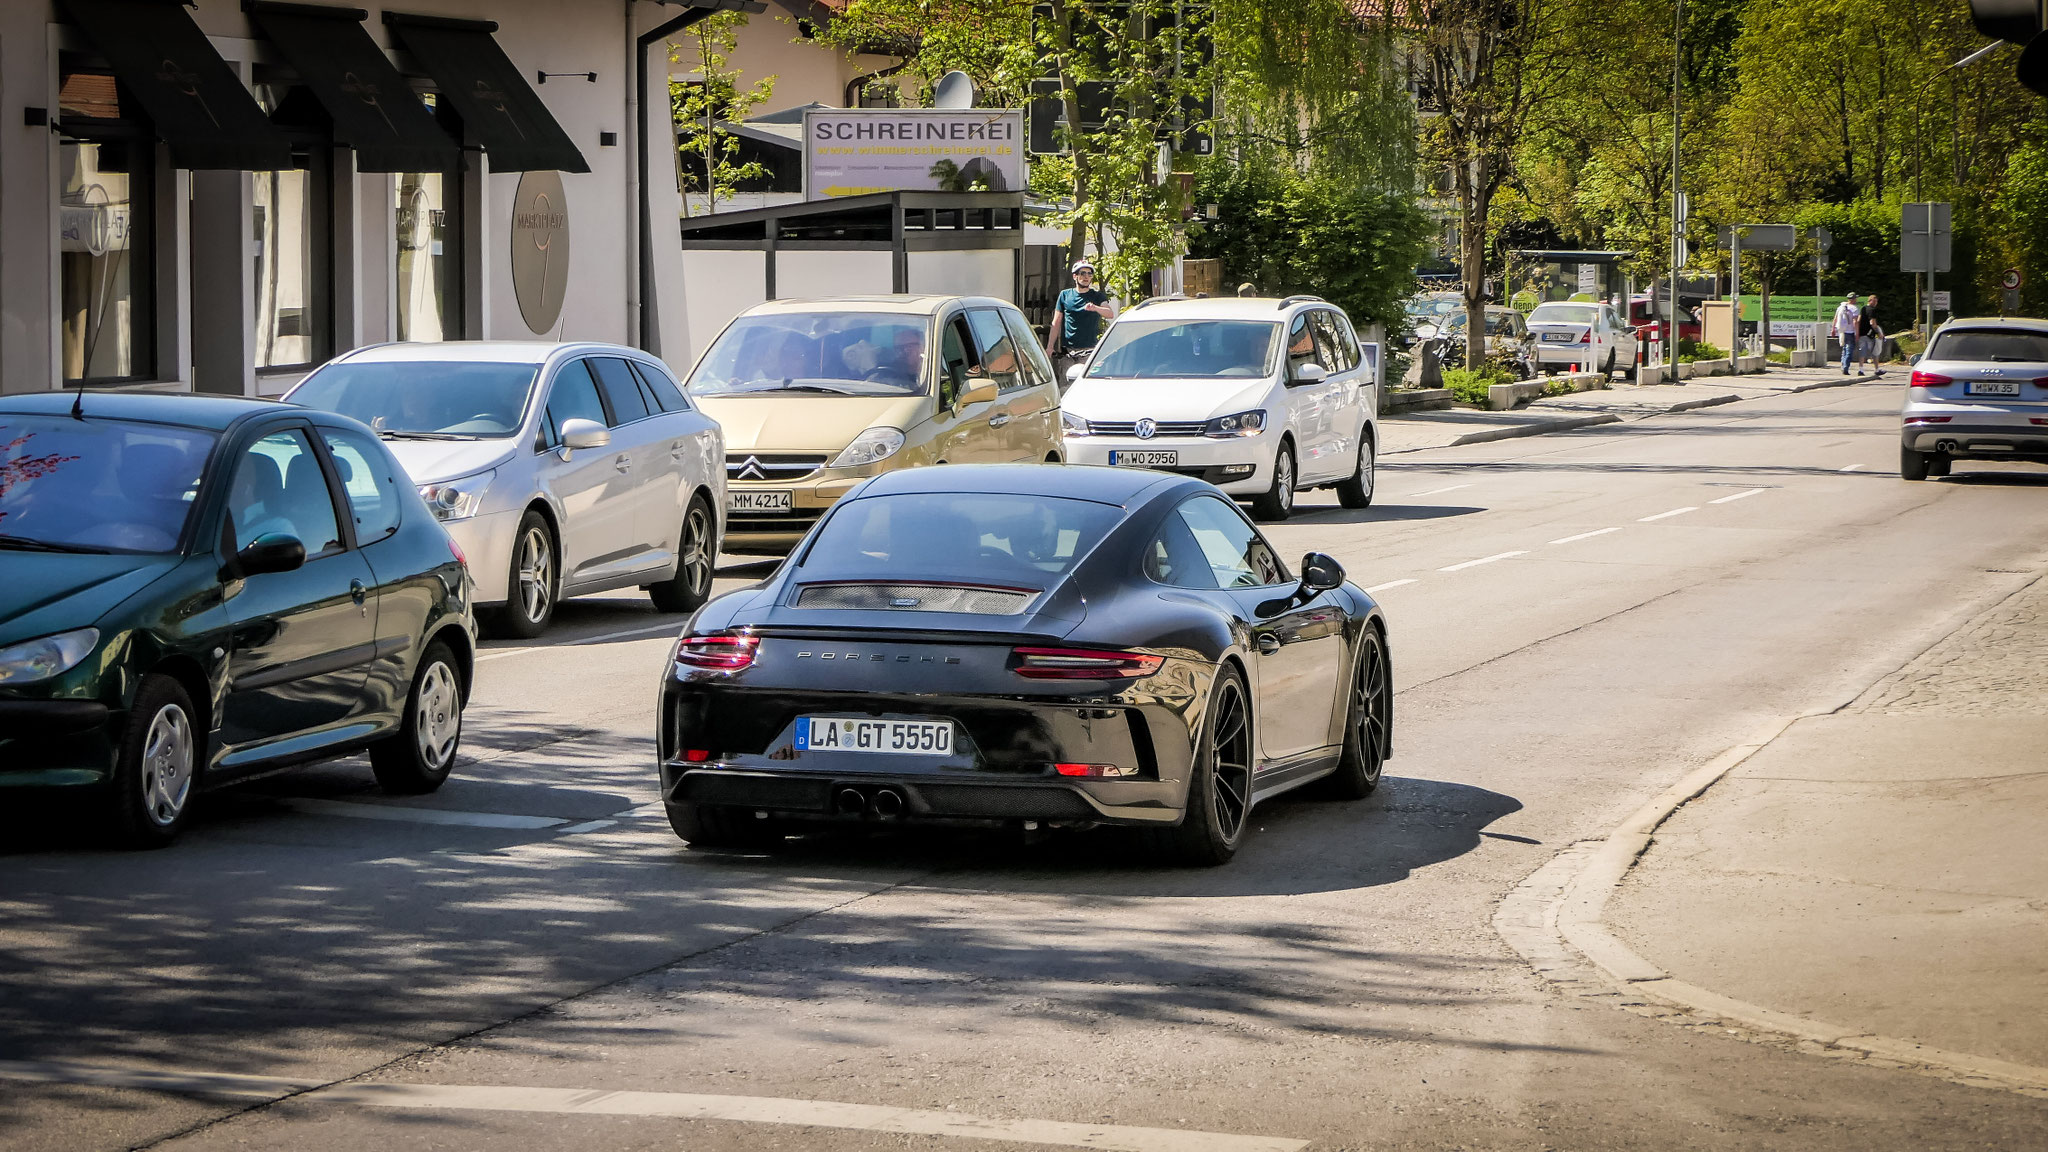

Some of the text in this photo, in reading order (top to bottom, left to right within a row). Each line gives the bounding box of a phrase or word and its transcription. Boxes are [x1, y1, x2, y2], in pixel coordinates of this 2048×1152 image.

[815, 122, 1012, 140] SCHREINEREI
[517, 213, 565, 229] MARKTPLATZ
[1975, 383, 2013, 393] M WX 35
[1116, 452, 1175, 464] M WO 2956
[734, 494, 789, 508] MM 4214
[797, 651, 961, 665] PORSCHE
[810, 720, 839, 747] LA
[857, 722, 887, 749] GT
[892, 724, 949, 751] 5550
